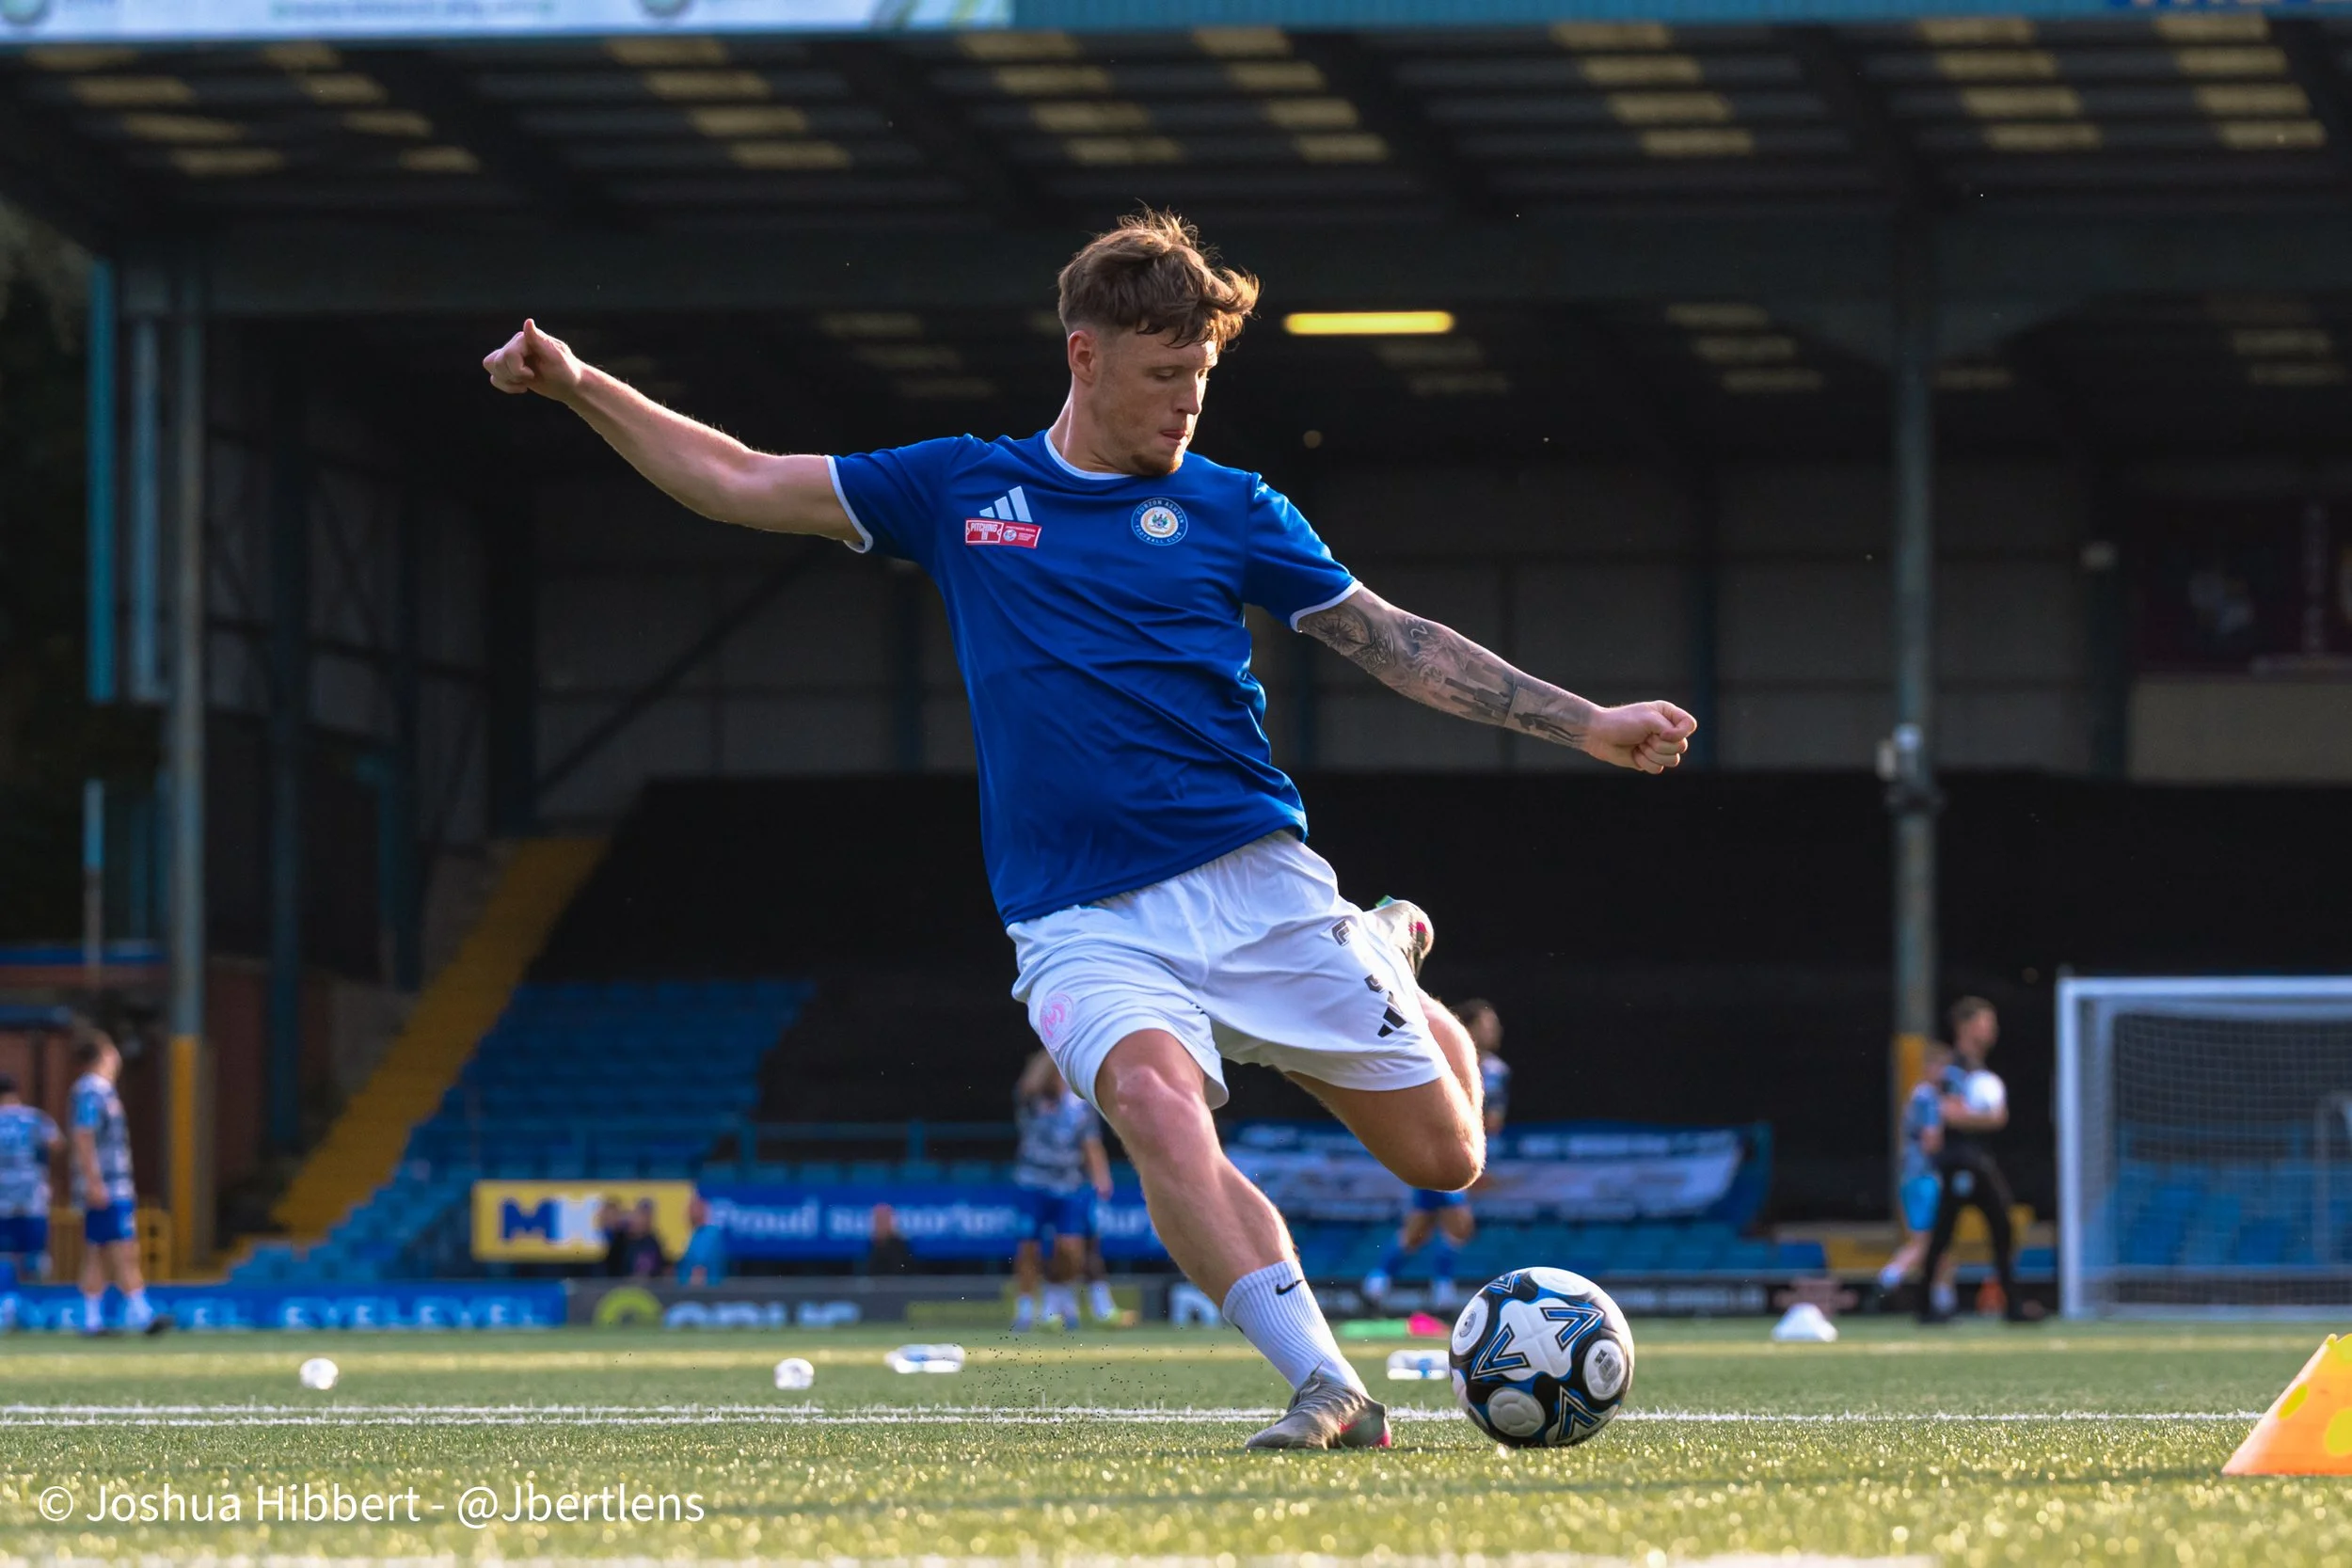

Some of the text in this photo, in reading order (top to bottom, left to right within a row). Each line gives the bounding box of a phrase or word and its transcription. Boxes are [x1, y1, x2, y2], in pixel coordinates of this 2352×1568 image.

[1136, 499, 1185, 523] CURZON ASHTON
[970, 522, 998, 533] PITCHING
[1136, 525, 1182, 544] FOOTBALL CLUB
[502, 1196, 653, 1243] MK
[278, 1296, 551, 1329] EYELEVEL
